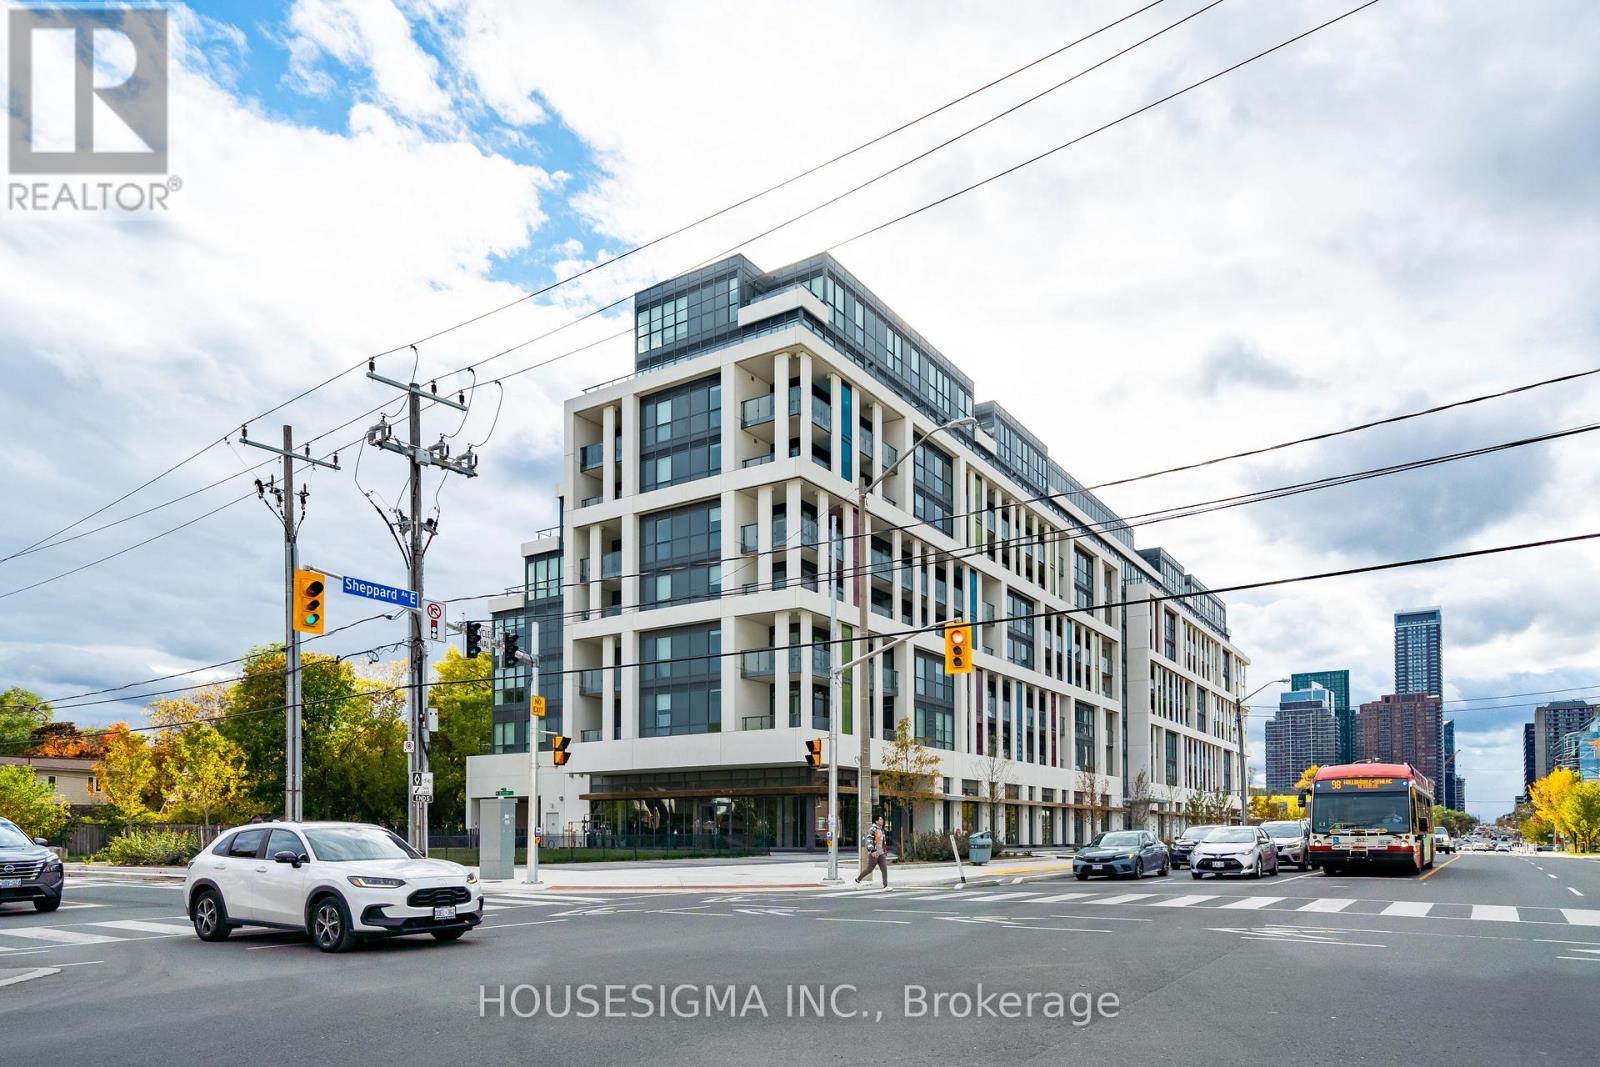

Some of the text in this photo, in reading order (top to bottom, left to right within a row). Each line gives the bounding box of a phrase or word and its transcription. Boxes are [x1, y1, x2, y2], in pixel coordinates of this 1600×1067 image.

[345, 578, 398, 601] Sheppard
[410, 593, 416, 605] E
[534, 697, 542, 706] NO
[533, 706, 544, 714] EXIT
[1331, 780, 1342, 790] 98
